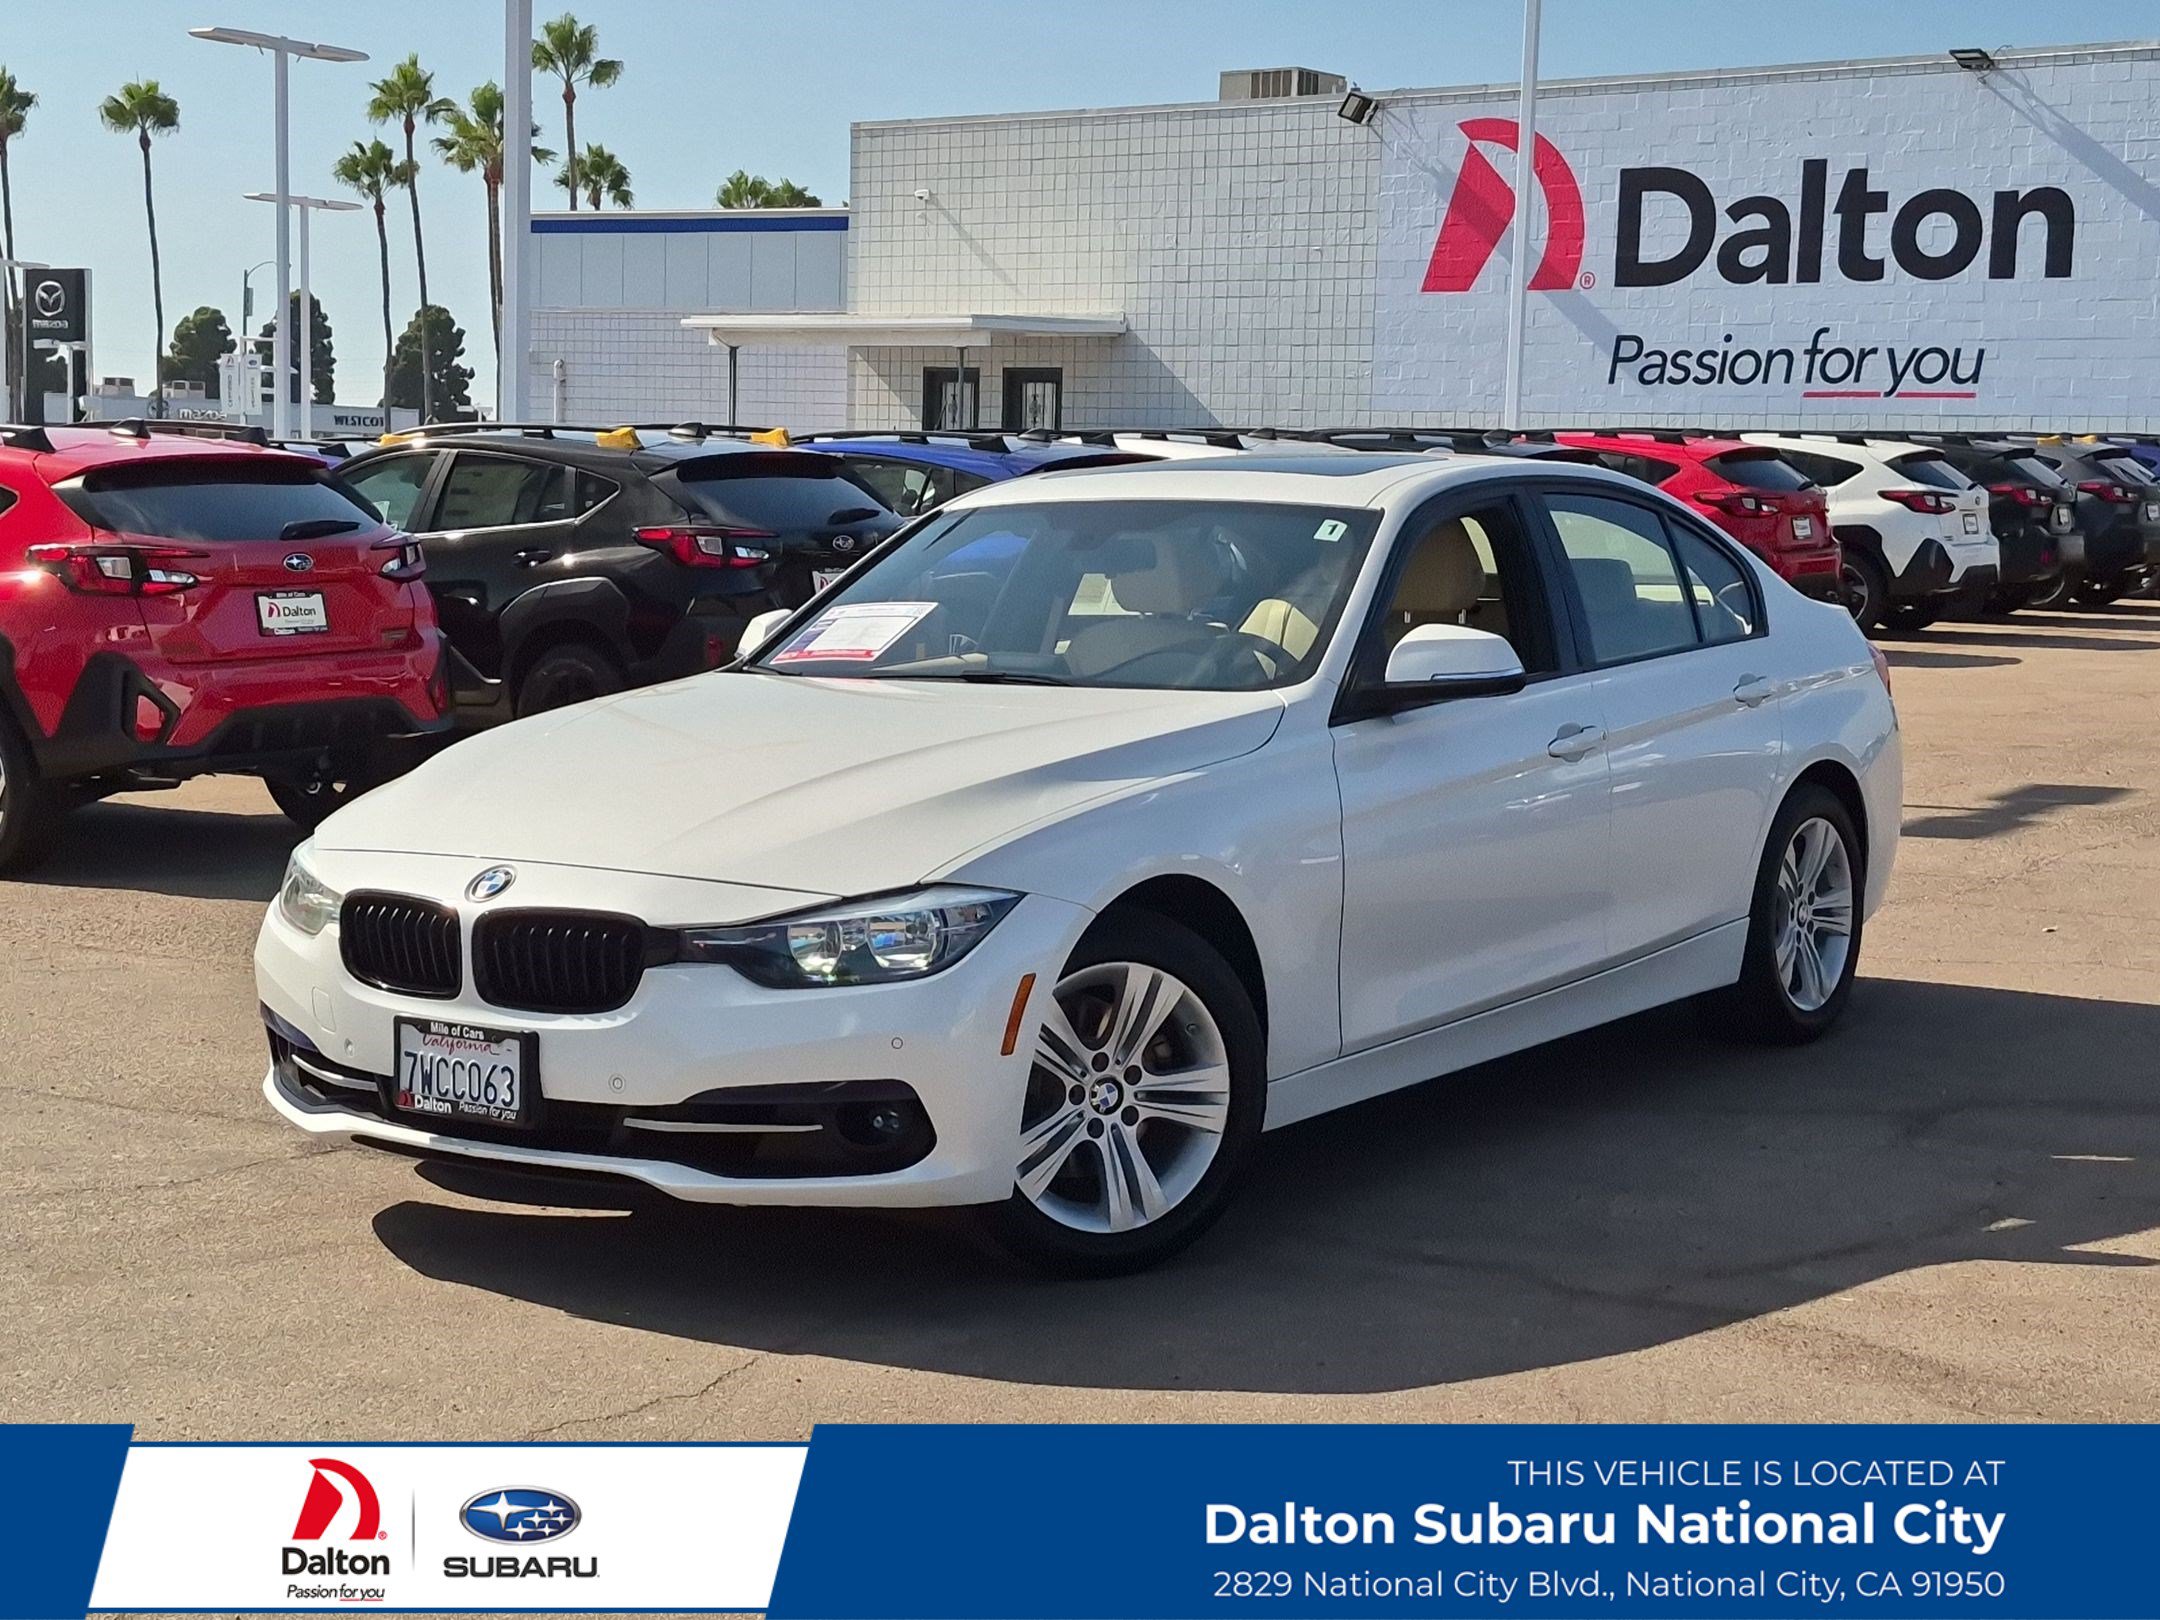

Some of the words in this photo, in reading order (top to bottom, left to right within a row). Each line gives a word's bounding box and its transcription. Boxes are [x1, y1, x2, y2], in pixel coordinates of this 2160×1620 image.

[1613, 158, 2075, 288] Dalton
[1608, 333, 1795, 386] Passion
[1803, 327, 1879, 385] for
[1883, 346, 1985, 398] you
[1327, 523, 1339, 536] 1
[282, 605, 317, 617] Dalton
[430, 1021, 449, 1035] Mile
[451, 1025, 461, 1036] of
[462, 1026, 485, 1040] Cars
[422, 1033, 500, 1055] California
[404, 1050, 515, 1108] 7WCC063
[414, 1094, 453, 1114] Dalton
[458, 1101, 488, 1116] Passion
[489, 1105, 501, 1117] for
[501, 1108, 517, 1121] you
